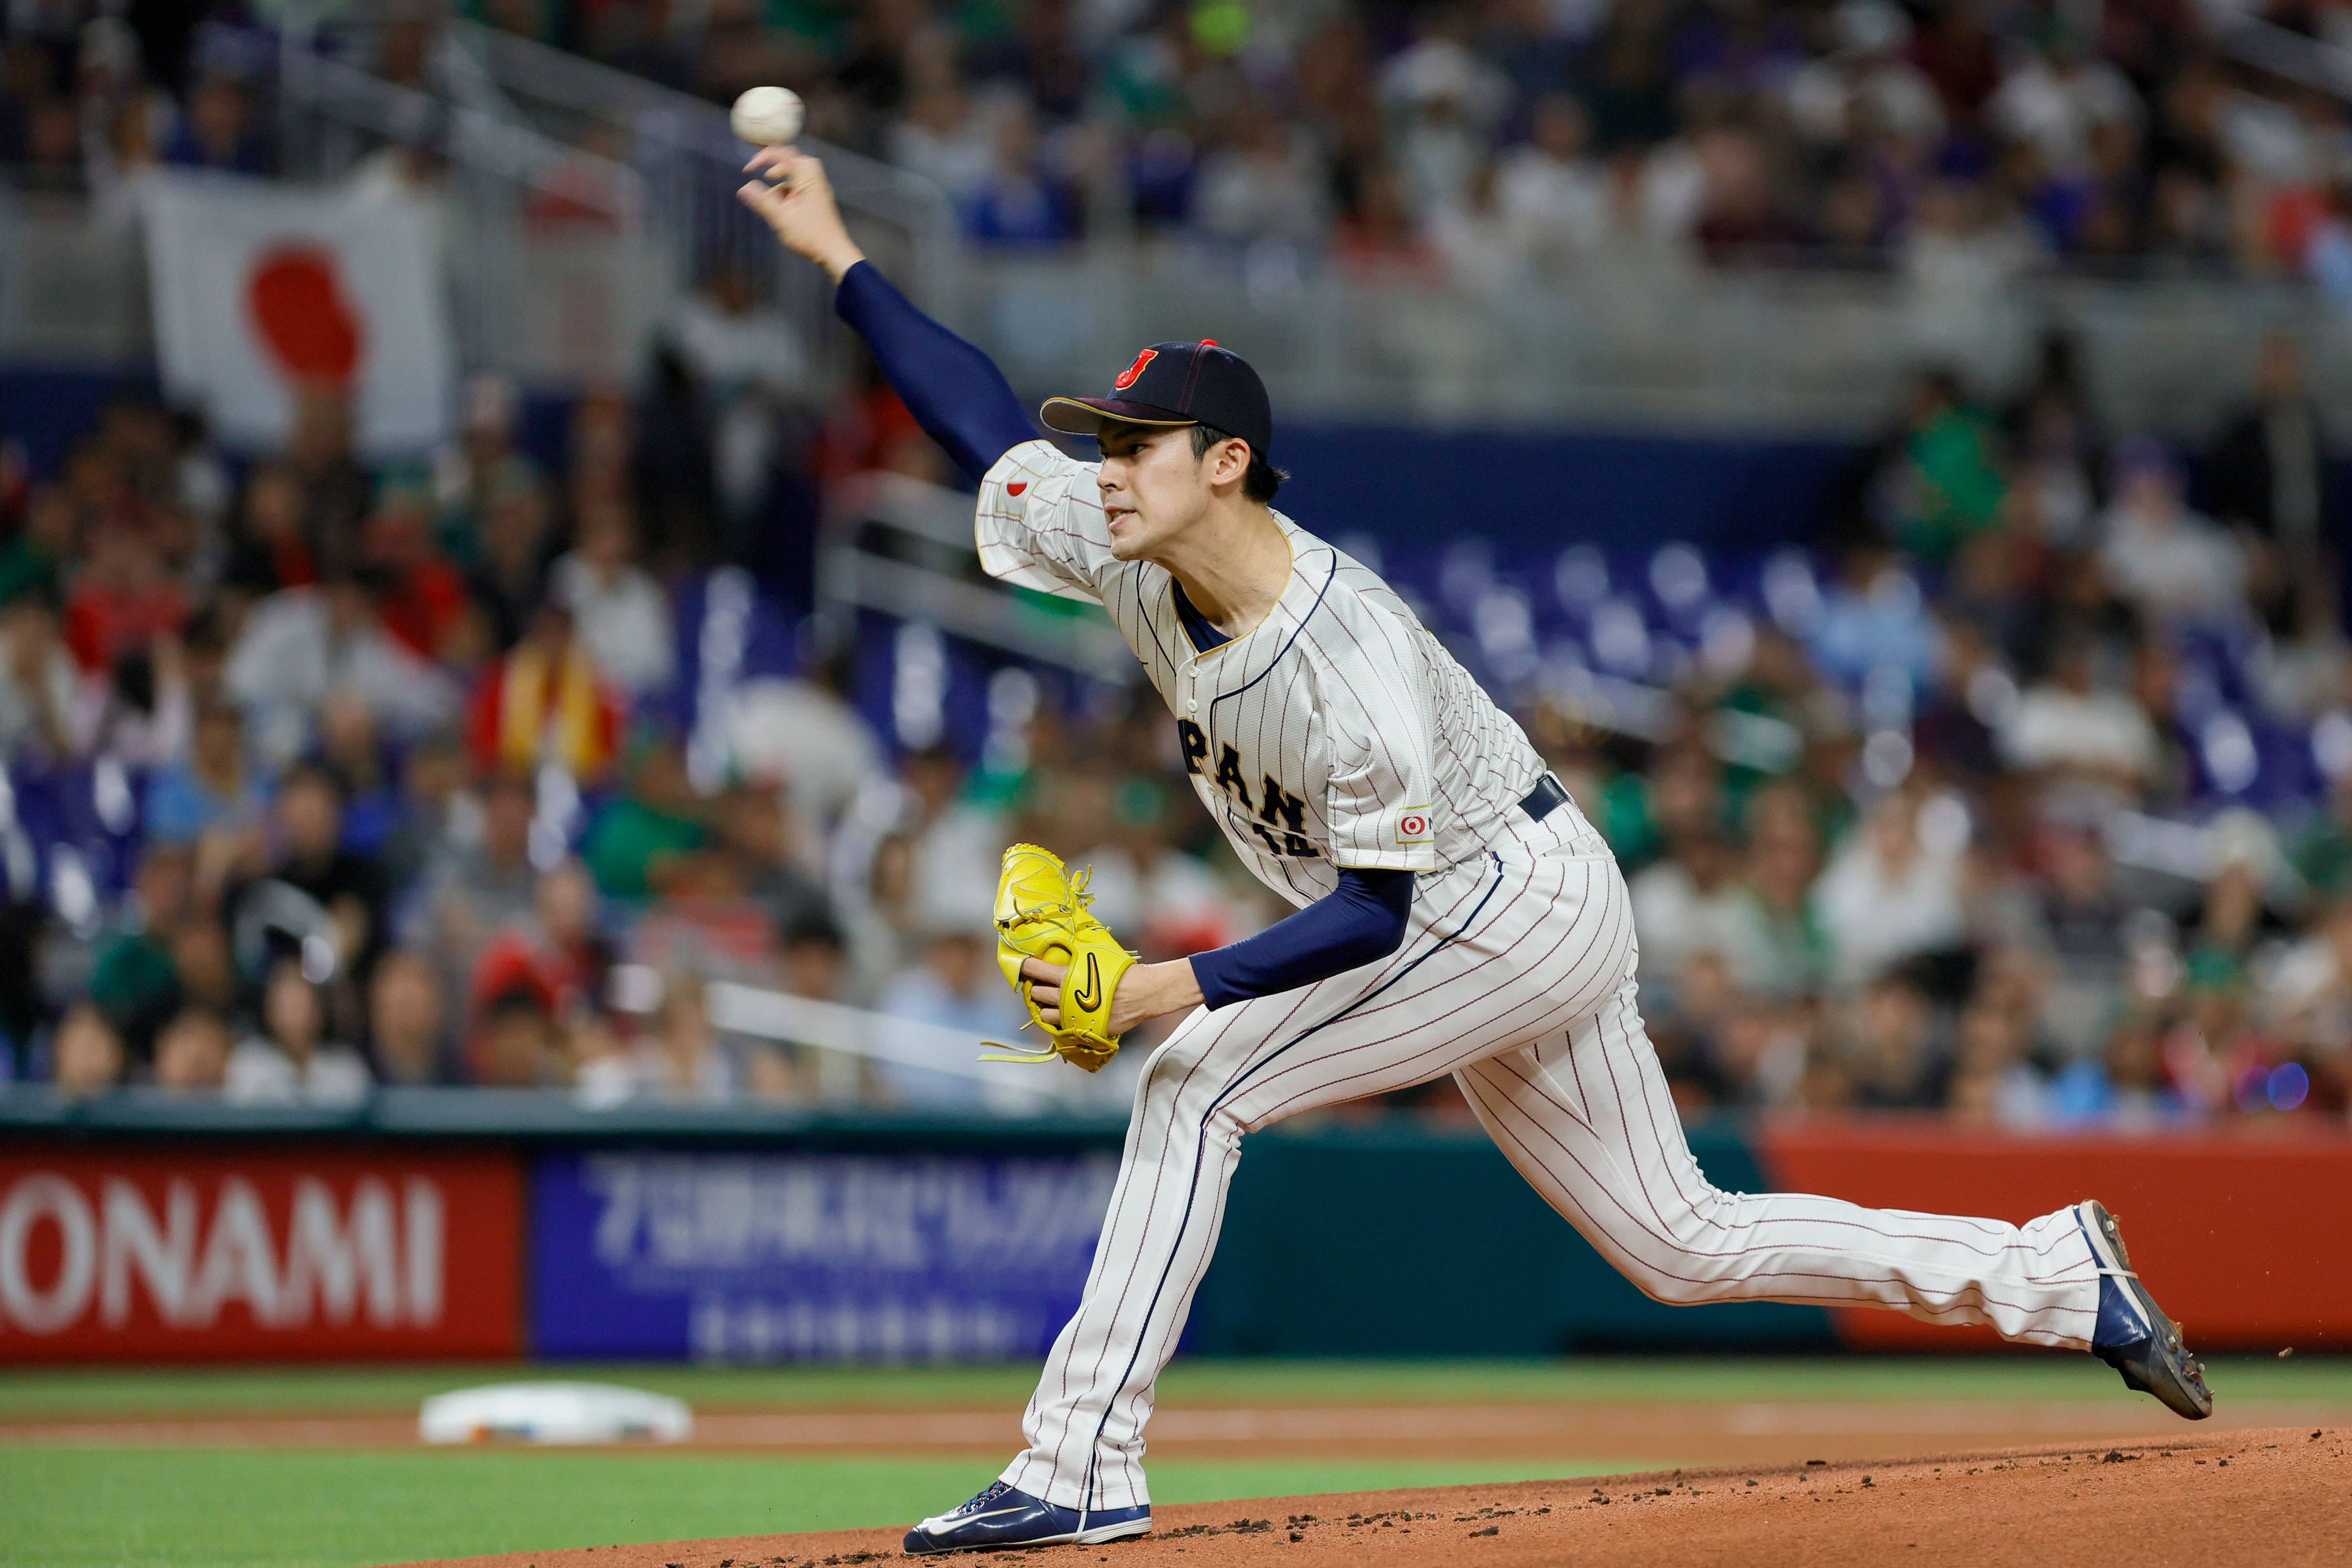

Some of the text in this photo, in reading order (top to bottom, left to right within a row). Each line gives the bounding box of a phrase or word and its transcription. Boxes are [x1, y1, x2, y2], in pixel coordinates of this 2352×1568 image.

[1115, 348, 1159, 391] J
[1252, 823, 1321, 858] 14
[0, 1172, 446, 1335] ONAMI
